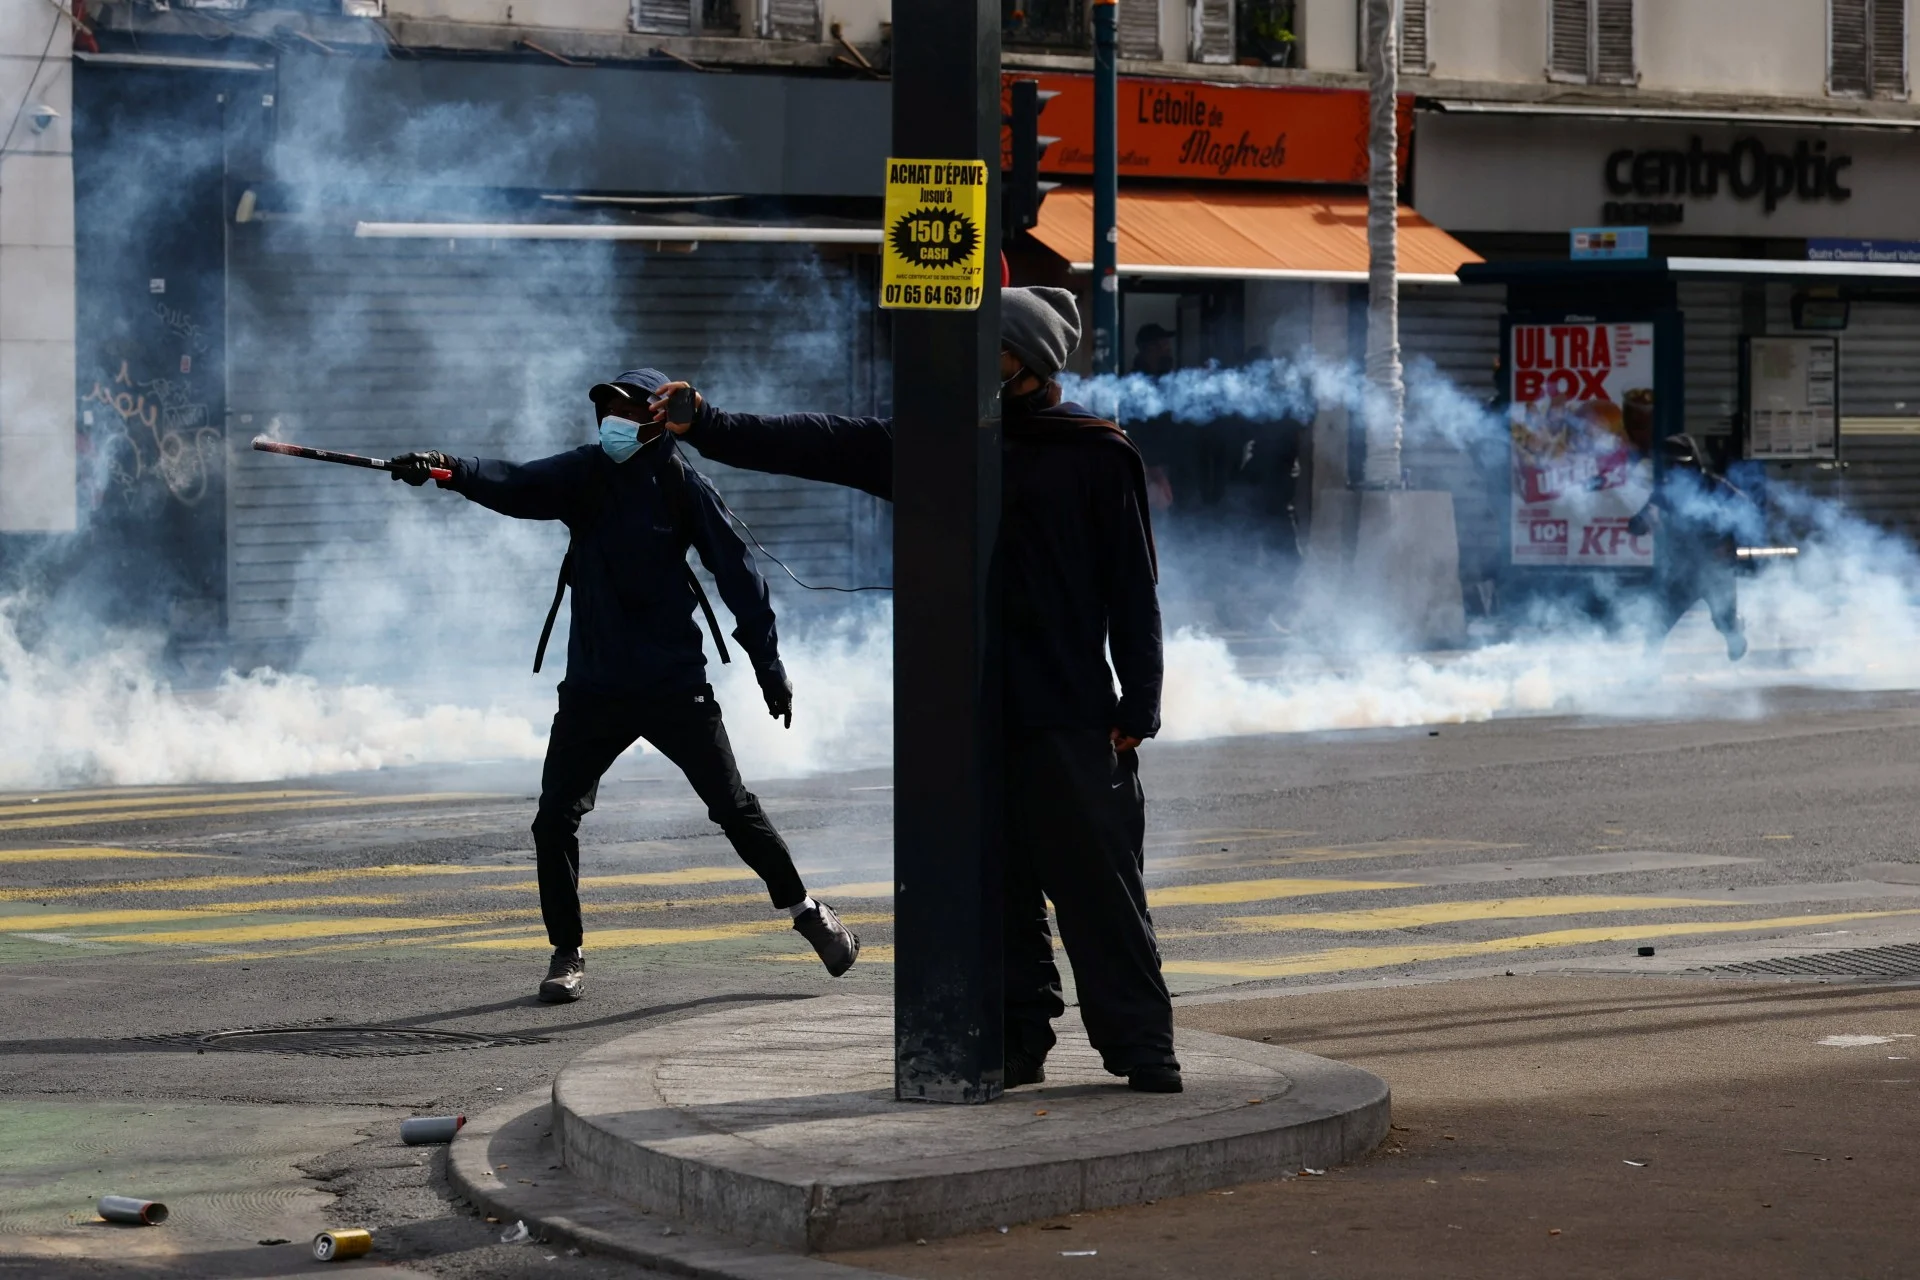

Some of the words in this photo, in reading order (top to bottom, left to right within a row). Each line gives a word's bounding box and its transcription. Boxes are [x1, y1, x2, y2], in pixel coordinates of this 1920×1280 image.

[1138, 87, 1206, 126] L'étoile
[1179, 130, 1287, 176] Maghreb
[890, 164, 932, 184] ACHAT
[934, 162, 983, 185] D'ÉPAVE
[920, 187, 952, 204] Jusqu'à
[908, 220, 944, 243] 150
[948, 220, 962, 243] €
[920, 247, 949, 260] CASH
[886, 284, 901, 303] 07
[904, 285, 921, 304] 65
[925, 285, 941, 304] 64
[944, 286, 961, 304] 63
[965, 286, 980, 305] 01
[1515, 324, 1611, 369] ULTRA
[1515, 369, 1612, 402] BOX
